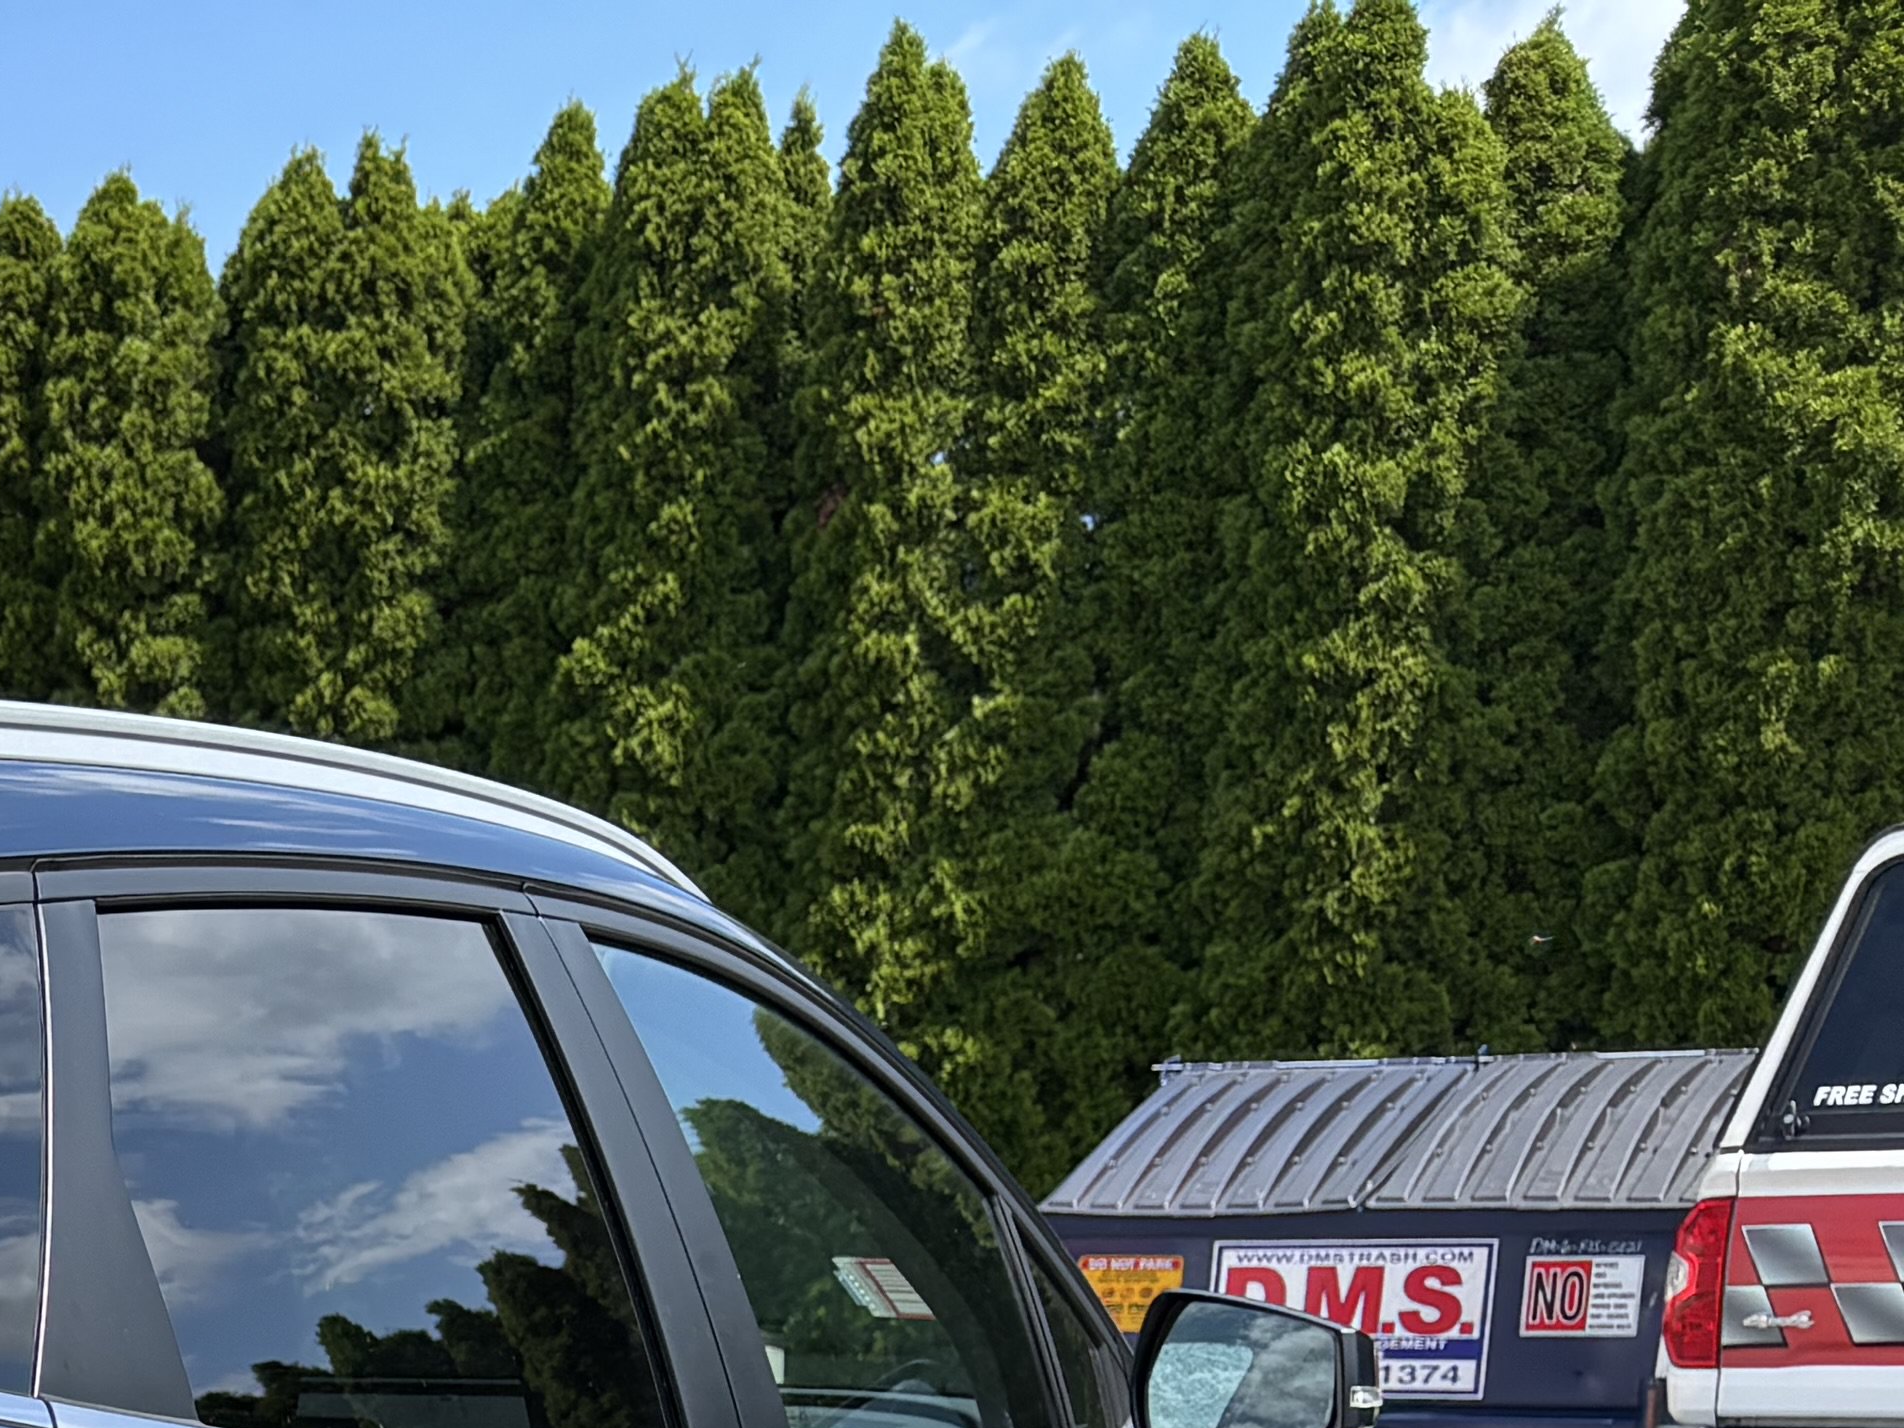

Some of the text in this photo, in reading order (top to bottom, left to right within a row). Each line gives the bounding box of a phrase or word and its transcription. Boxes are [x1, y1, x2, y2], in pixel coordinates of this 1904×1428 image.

[1813, 1084, 1878, 1106] FREE
[1237, 1249, 1474, 1265] WWW.DMSTRASH.COM
[1225, 1264, 1475, 1335] DM.S.
[1530, 1267, 1586, 1323] NO
